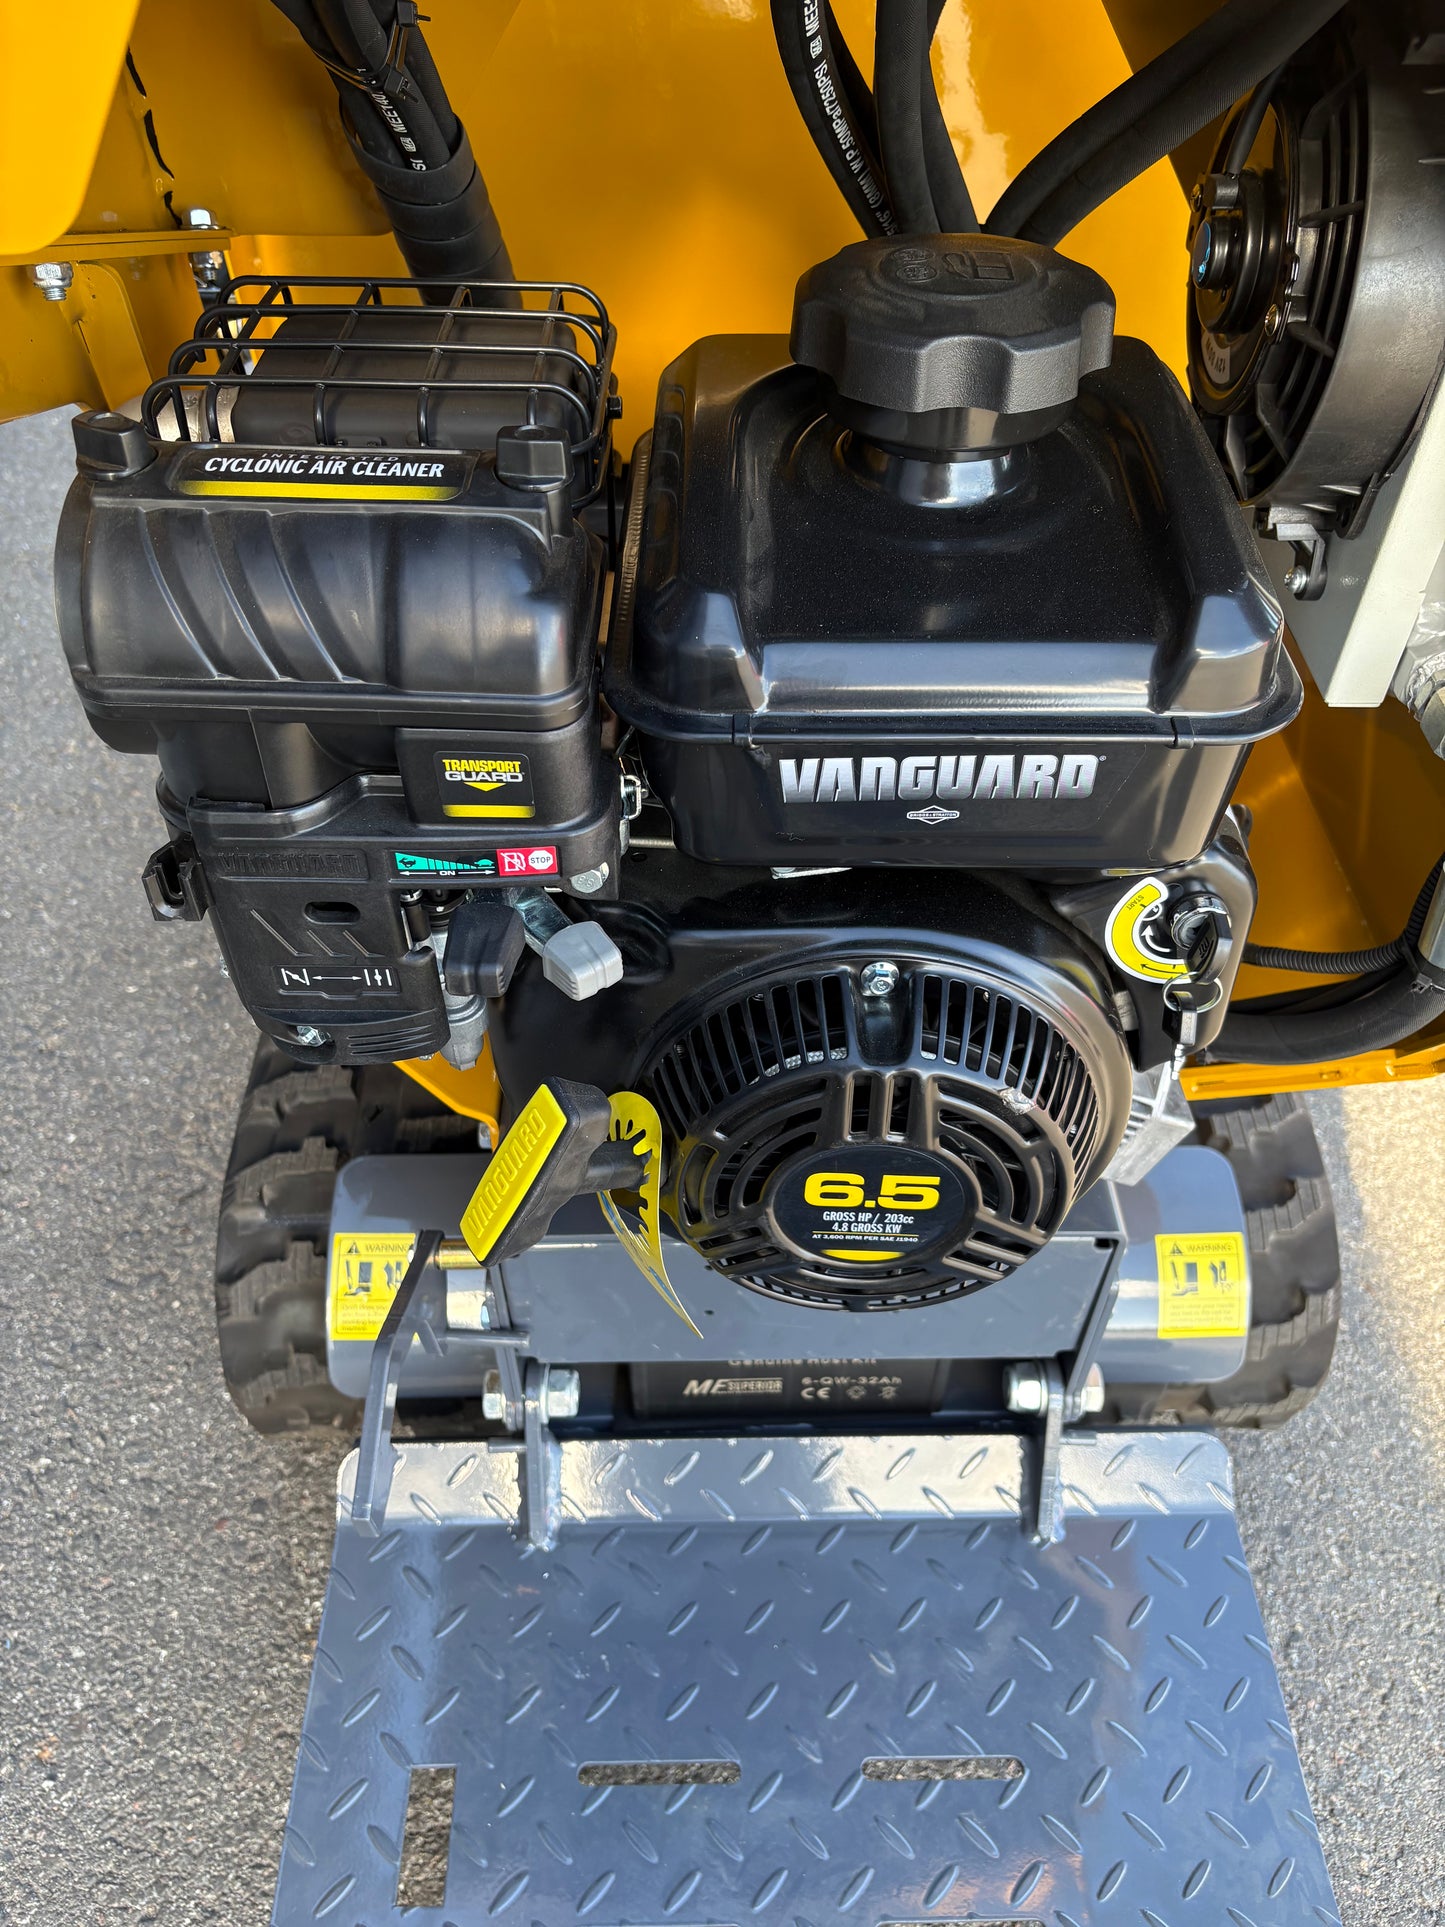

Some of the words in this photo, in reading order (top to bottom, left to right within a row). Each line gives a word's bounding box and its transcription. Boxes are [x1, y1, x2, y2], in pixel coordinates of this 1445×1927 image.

[804, 0, 820, 37] MEE
[261, 453, 399, 461] INTEGRATED
[204, 457, 308, 475] CYCLONIC
[308, 460, 347, 475] AIR
[352, 461, 444, 477] CLEANER
[442, 759, 521, 773] TRANSPORT
[530, 857, 551, 865] STOP
[1127, 894, 1145, 911] START
[467, 1108, 547, 1239] VANGUARD
[804, 1172, 941, 1210] 6.5
[822, 1211, 856, 1222] GROSS
[884, 1213, 914, 1224] 203cc
[832, 1223, 848, 1232] 4.8
[850, 1223, 883, 1233] GROSS
[885, 1224, 902, 1233] KW
[1187, 1243, 1232, 1253] WARNING
[682, 1379, 727, 1395] MF
